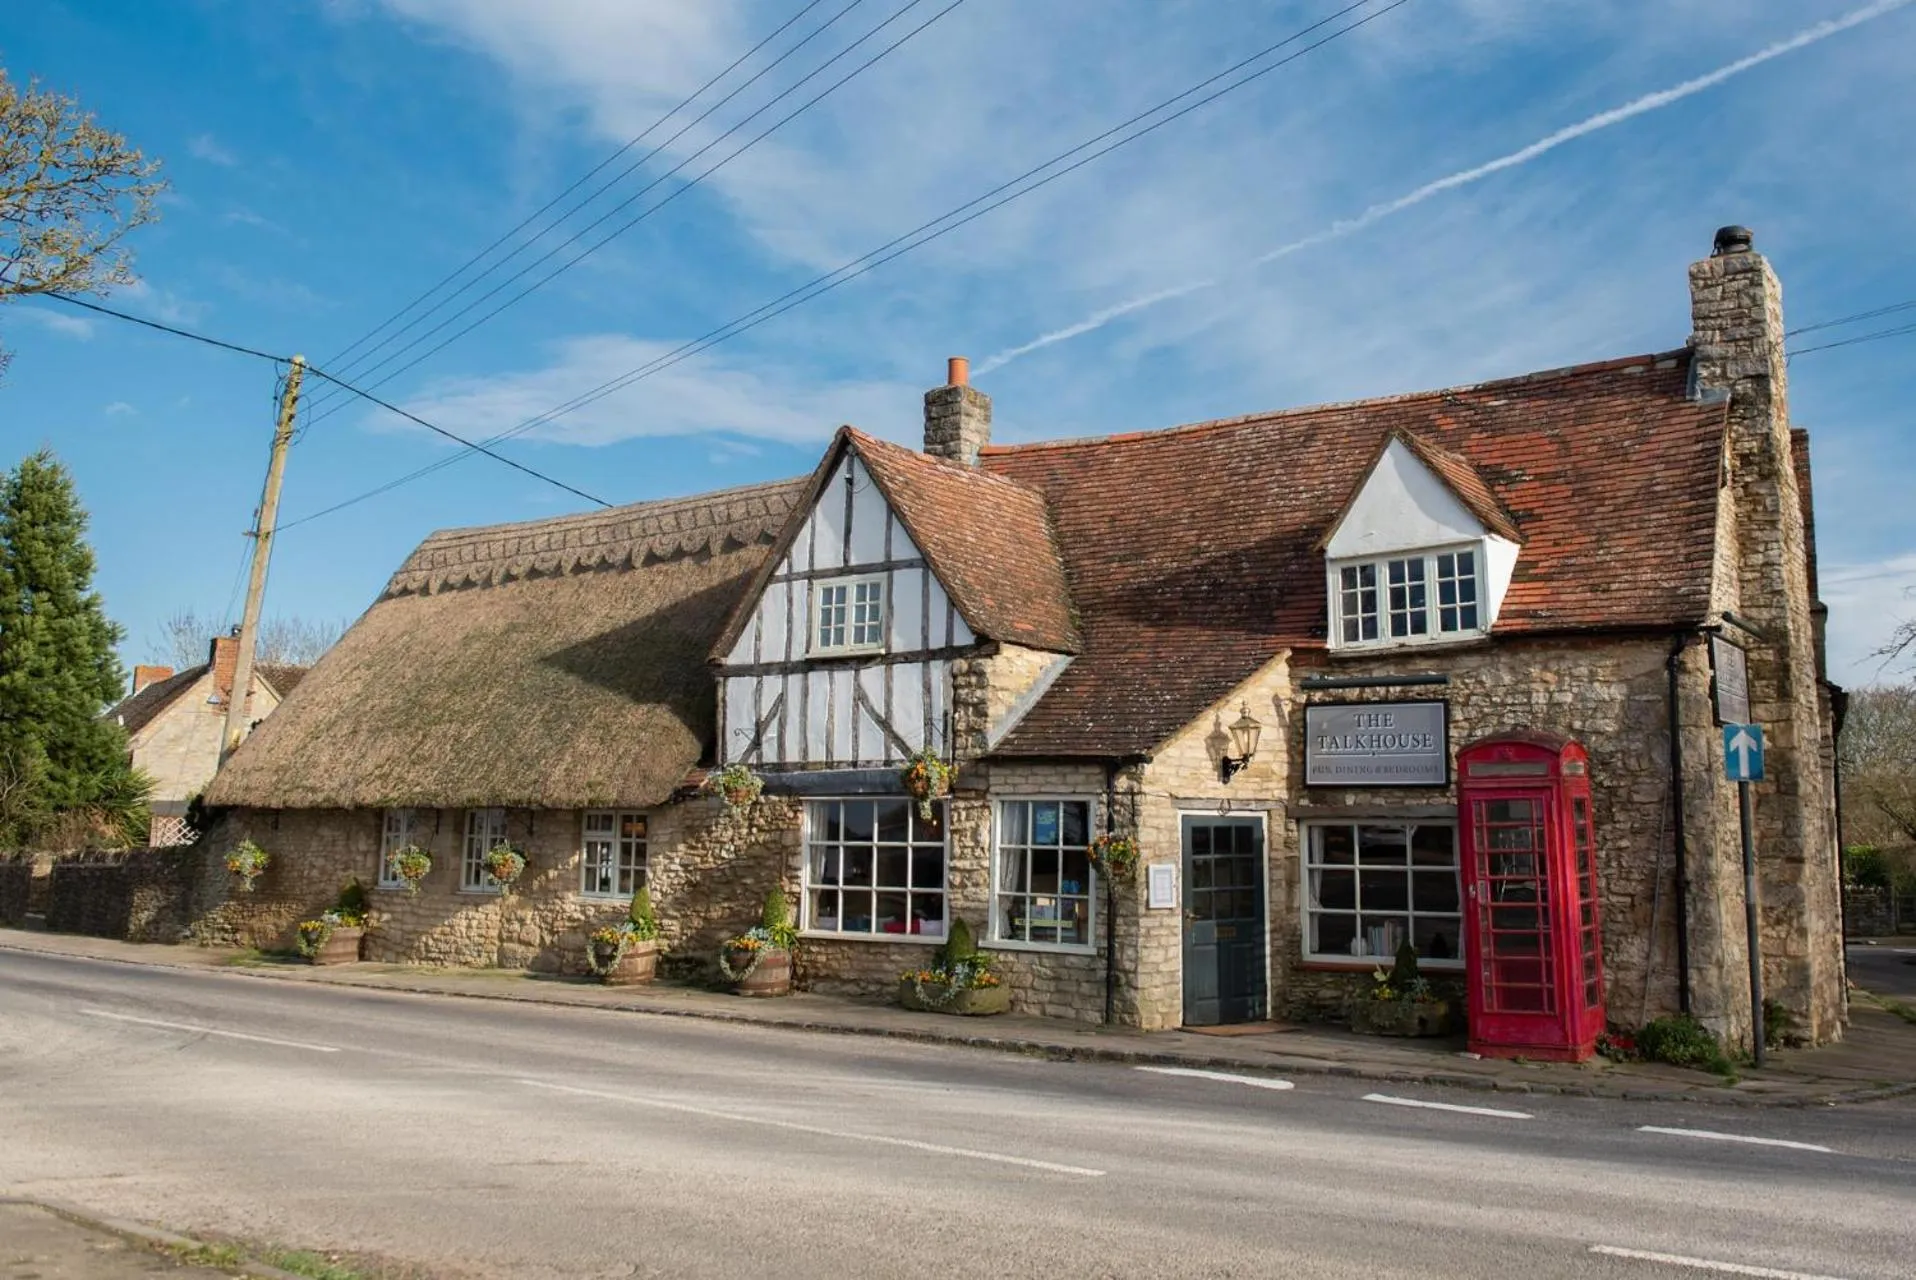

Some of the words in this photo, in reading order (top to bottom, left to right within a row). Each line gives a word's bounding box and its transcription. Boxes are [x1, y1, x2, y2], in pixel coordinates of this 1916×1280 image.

[1353, 713, 1395, 729] THE
[1317, 734, 1434, 752] TALKHOUSE
[1335, 765, 1374, 775] DINING
